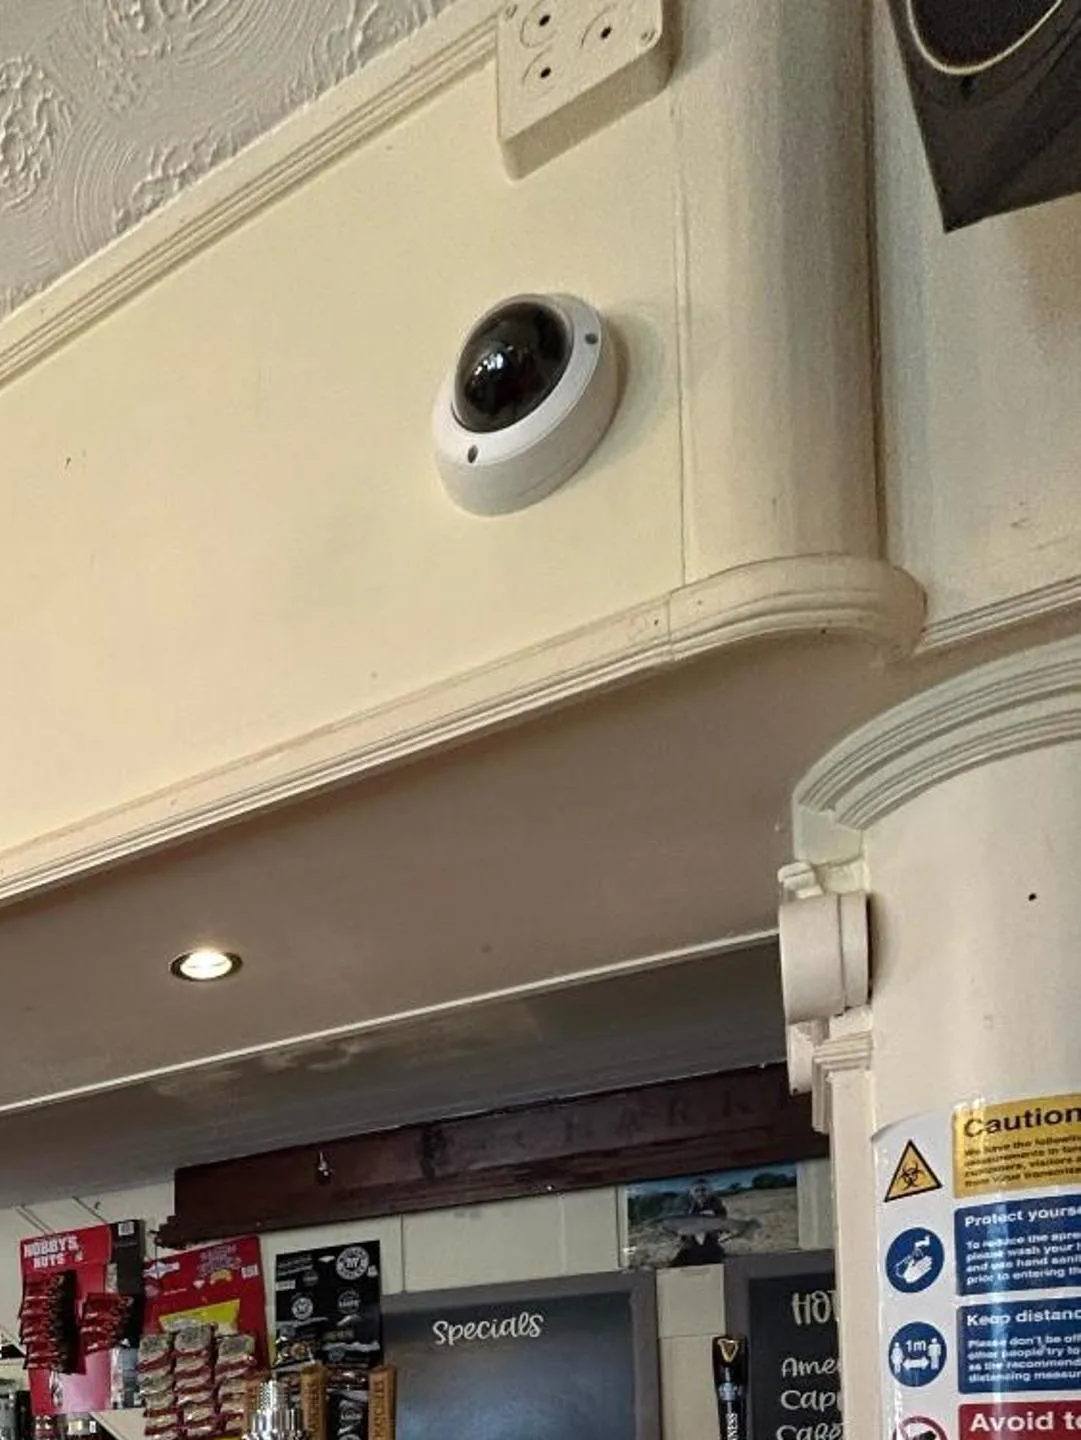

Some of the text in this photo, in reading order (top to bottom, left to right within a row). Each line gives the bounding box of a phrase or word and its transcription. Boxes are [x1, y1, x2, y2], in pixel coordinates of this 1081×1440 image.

[964, 1107, 1081, 1138] Caution
[965, 1210, 1023, 1227] Protect
[1043, 1243, 1075, 1255] your
[1016, 1257, 1048, 1268] hand
[1012, 1268, 1066, 1280] entering
[966, 1314, 1011, 1327] Keep
[432, 1311, 544, 1346] Specials
[1045, 1334, 1062, 1343] be
[905, 1340, 927, 1353] 1m
[781, 1357, 839, 1378] Ame
[781, 1389, 840, 1413] Cap
[969, 1411, 1054, 1432] Avoid
